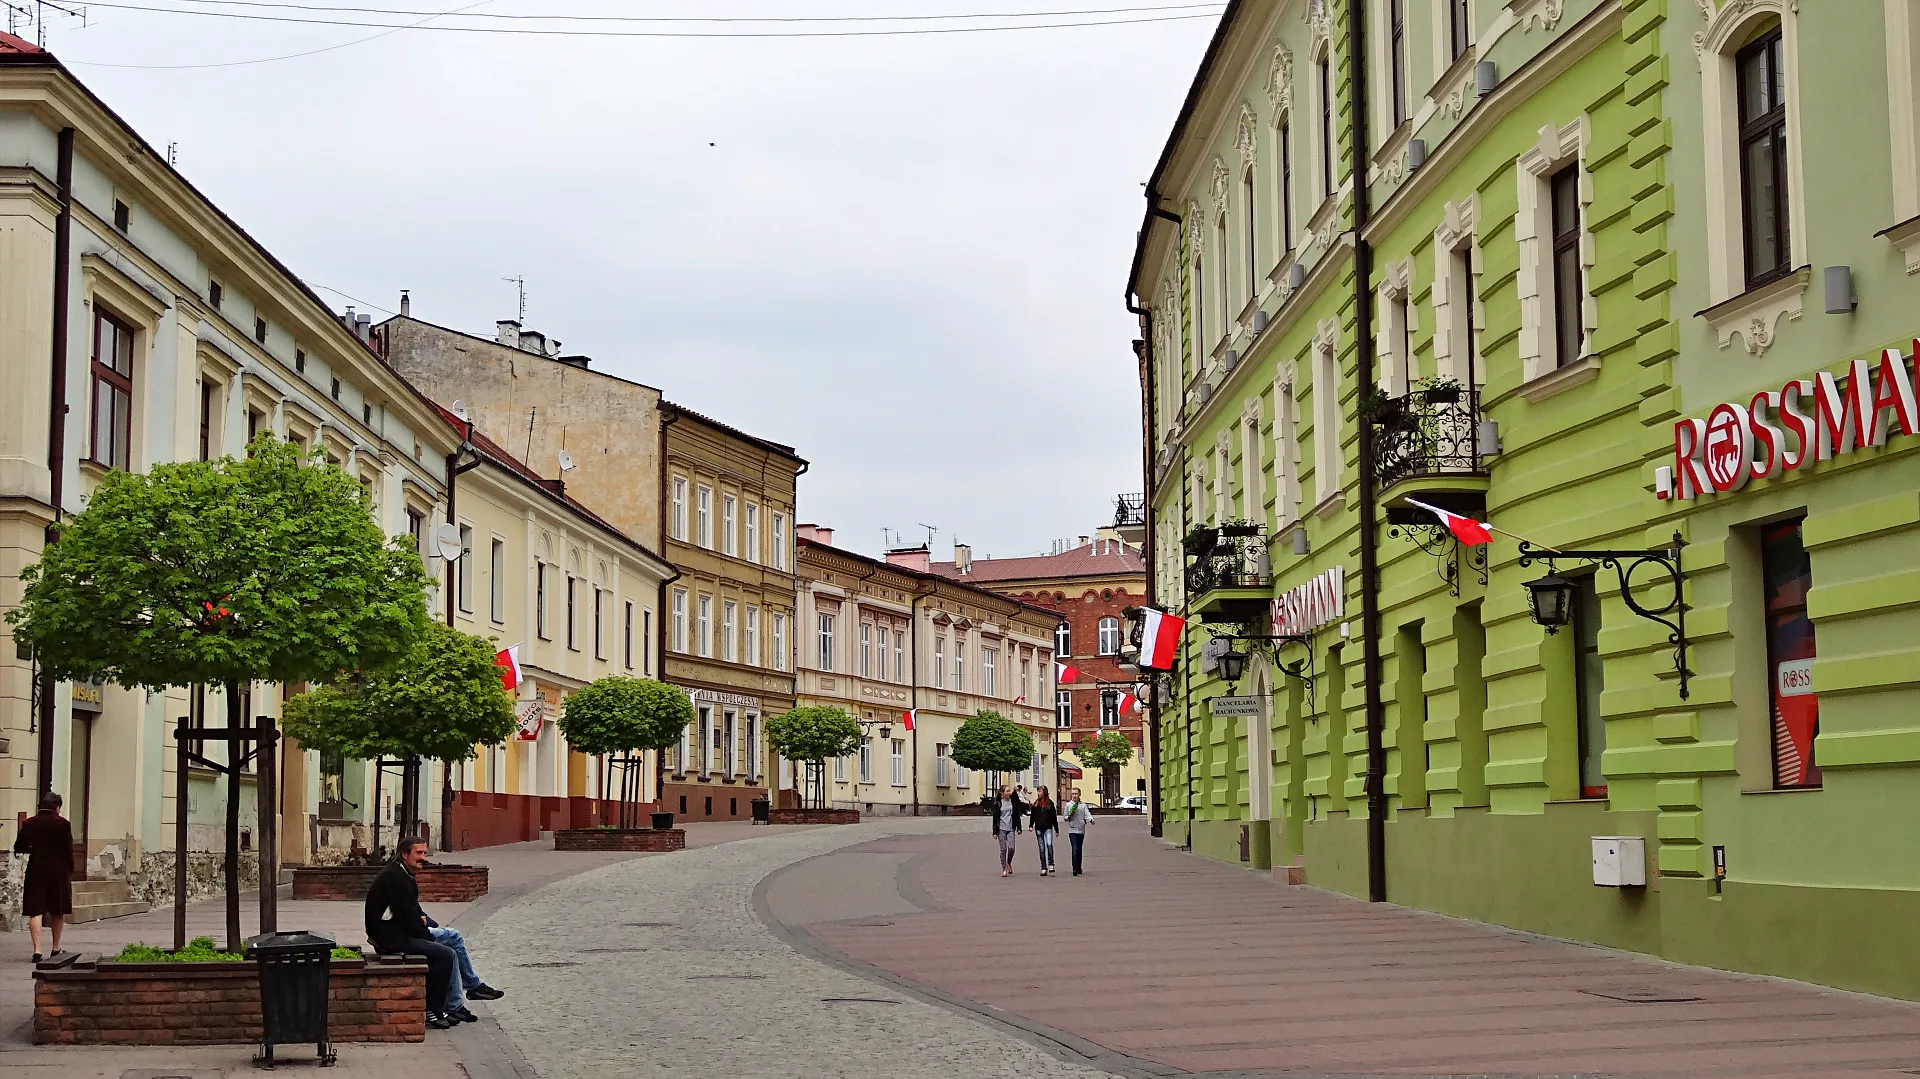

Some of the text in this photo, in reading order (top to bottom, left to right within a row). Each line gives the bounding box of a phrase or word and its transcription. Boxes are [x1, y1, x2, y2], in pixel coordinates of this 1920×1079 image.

[1675, 338, 1920, 500] ROSSMA
[1270, 565, 1343, 643] ROSSMANN
[1783, 668, 1812, 689] ROSS
[518, 702, 537, 722] Euro
